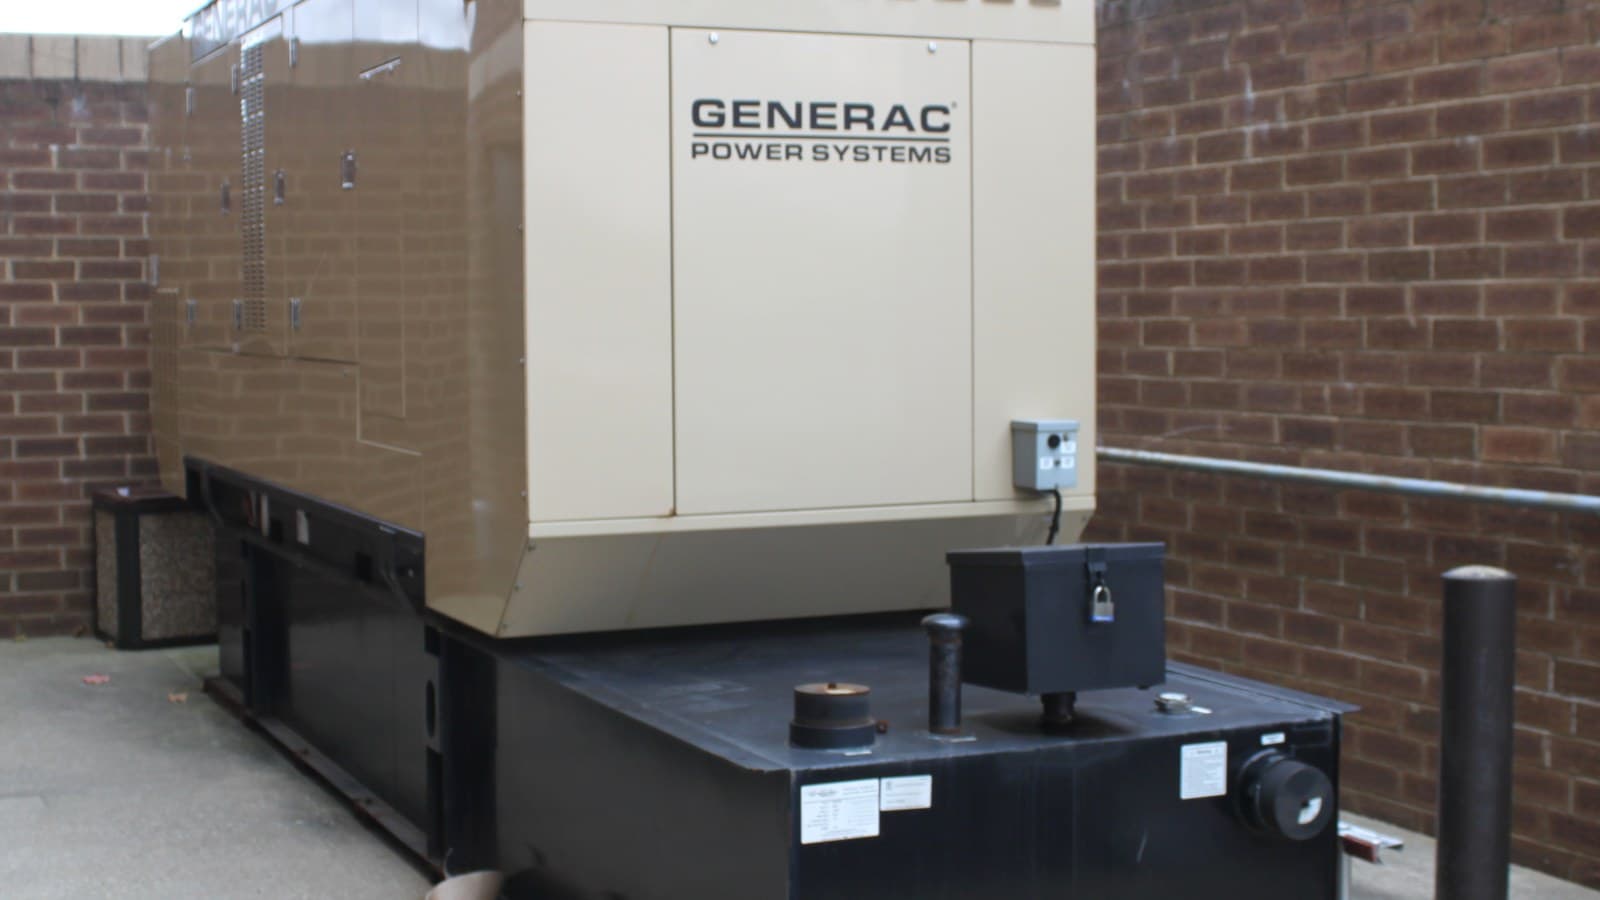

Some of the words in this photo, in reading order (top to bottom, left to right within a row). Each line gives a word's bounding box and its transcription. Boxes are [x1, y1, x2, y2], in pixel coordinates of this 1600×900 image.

[691, 98, 951, 132] GENERAC
[691, 142, 803, 161] POWER
[812, 144, 951, 164] SYSTEMS
